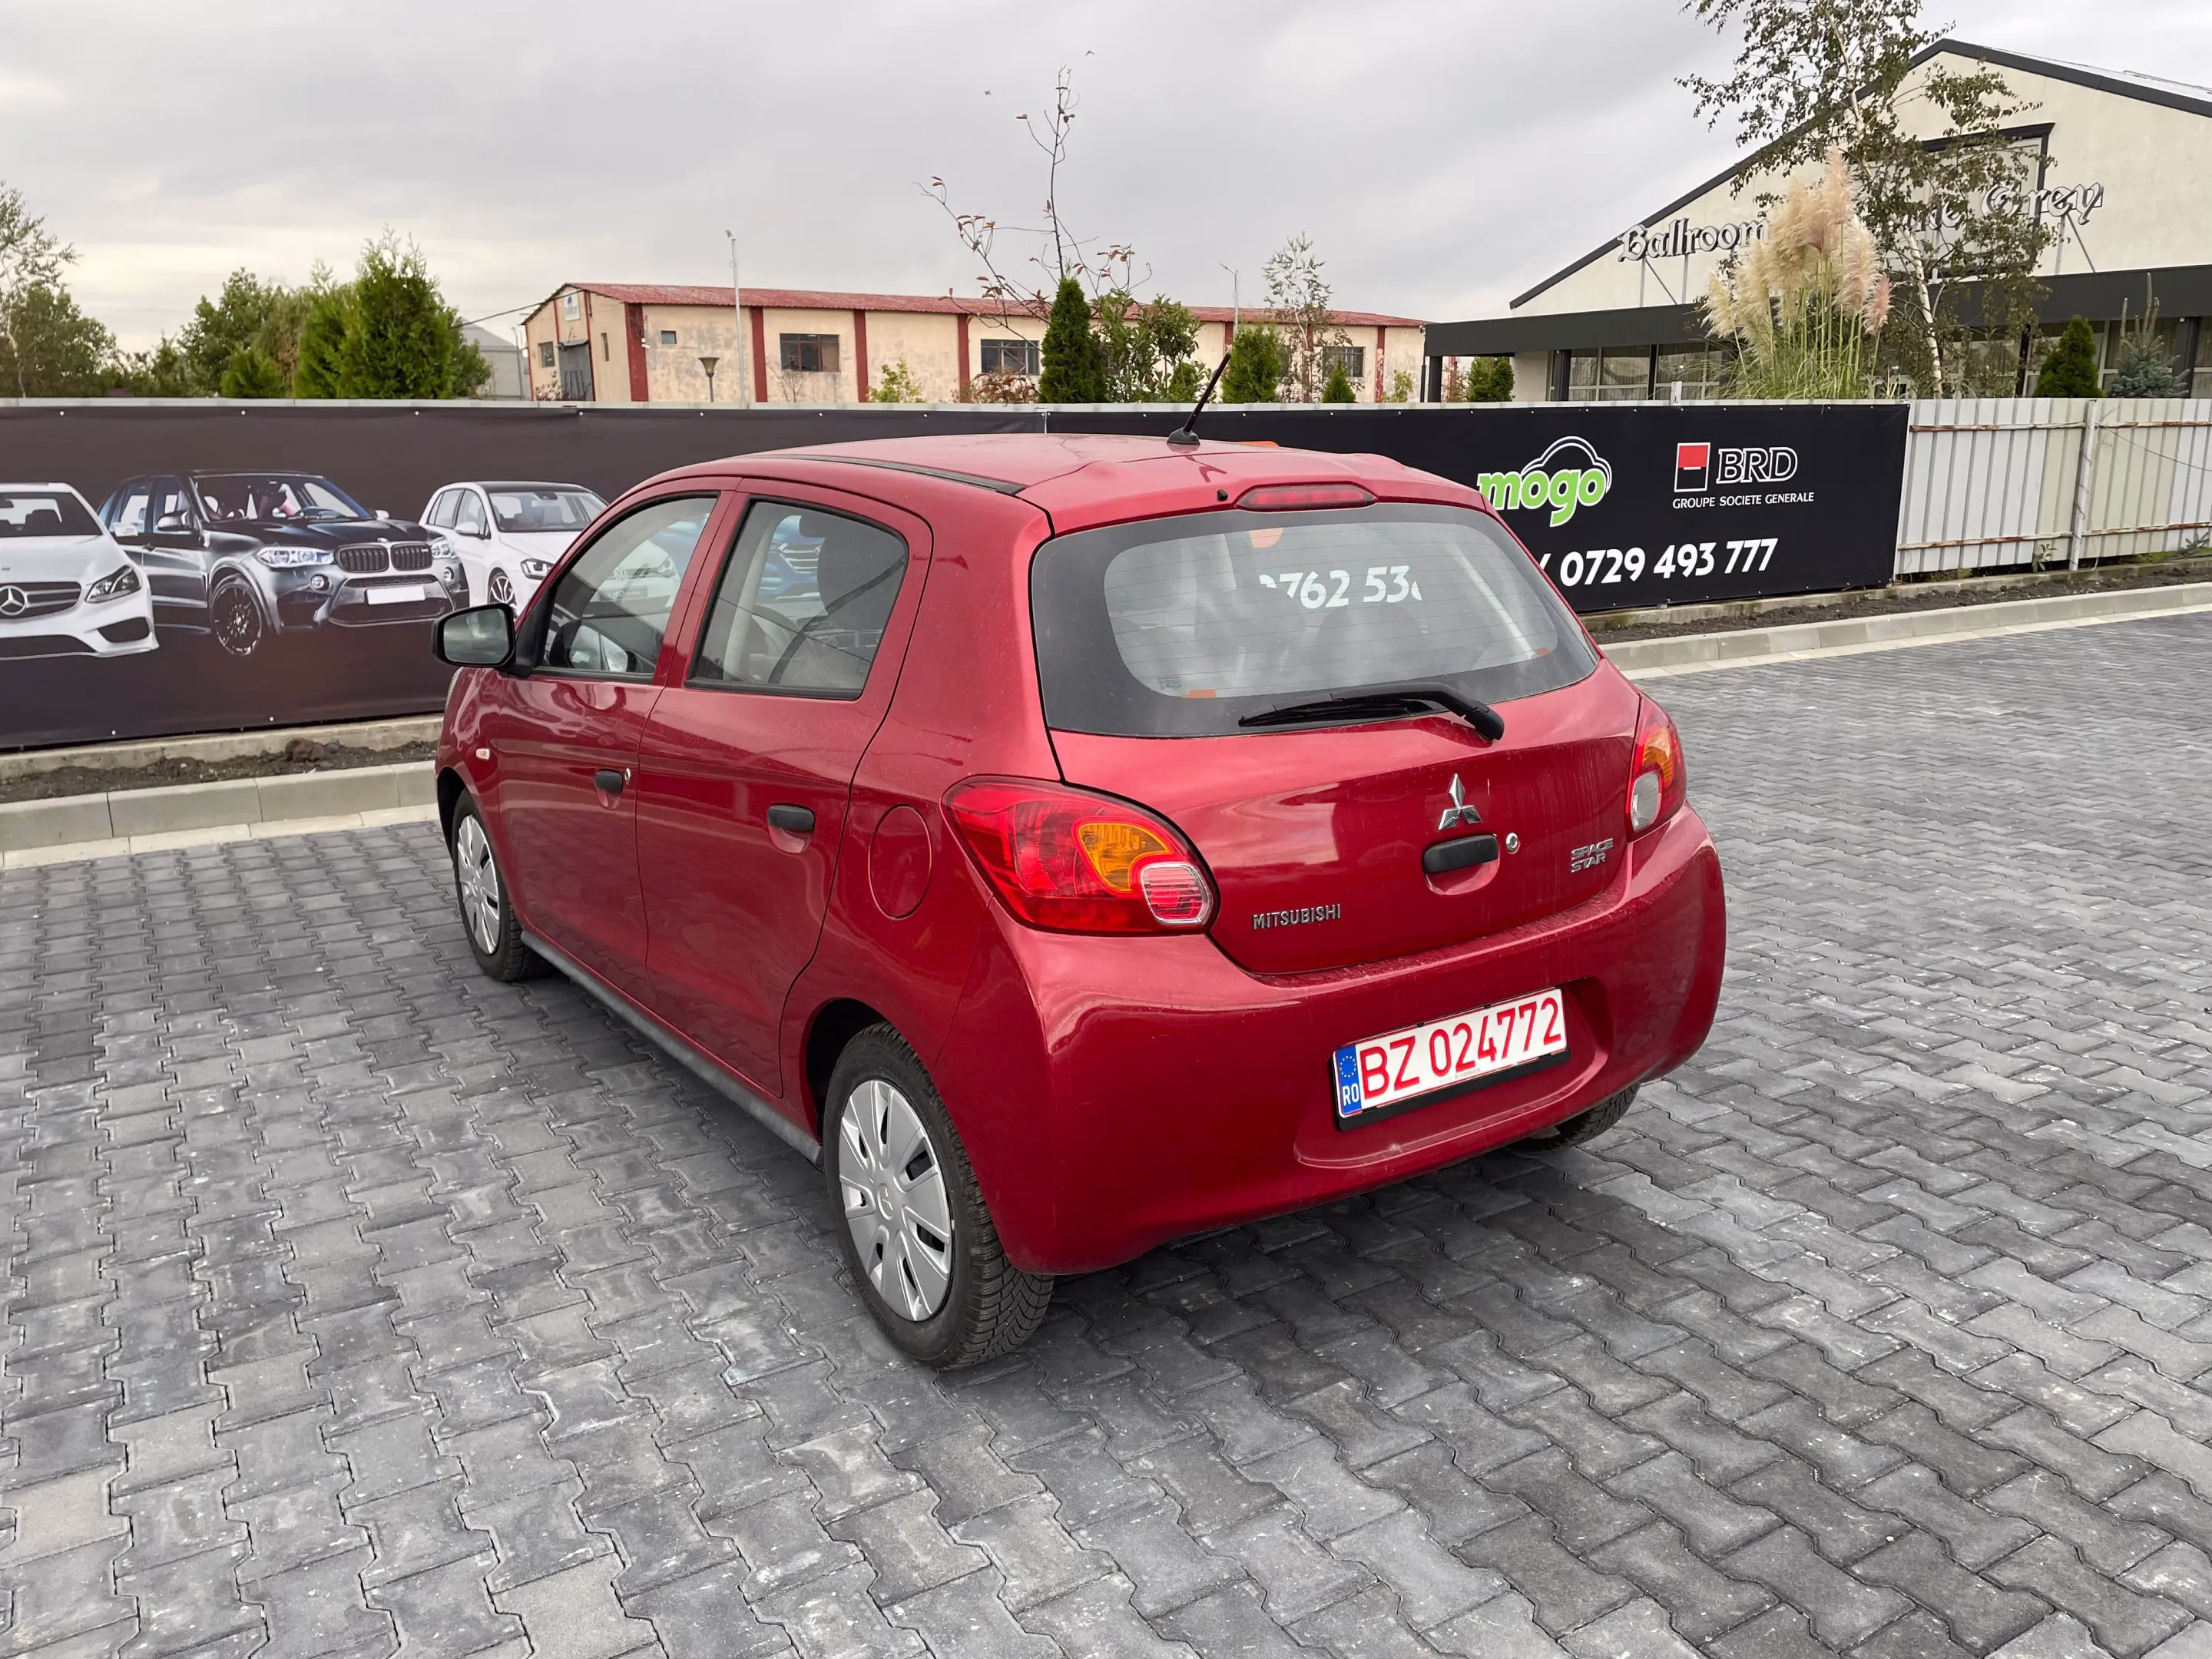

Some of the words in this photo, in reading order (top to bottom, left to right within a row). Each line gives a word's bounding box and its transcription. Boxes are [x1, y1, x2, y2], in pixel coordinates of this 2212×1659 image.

[1618, 218, 1769, 262] Ballroom
[1715, 446, 1798, 485] BRD
[1477, 468, 1608, 528] mogo
[1672, 497, 1716, 509] GROUPE
[1719, 495, 1762, 507] SOCIETE
[1765, 492, 1815, 505] GENERALE
[1259, 569, 1350, 609] 762
[1560, 547, 1646, 587] 0729
[1653, 542, 1715, 579] 493
[1724, 538, 1779, 575] 777
[1571, 837, 1614, 860] SPACE
[1571, 853, 1606, 873] STAR
[1253, 903, 1341, 930] MITSUBISHI
[1342, 1083, 1359, 1107] RO
[1359, 1035, 1420, 1100] BZ
[1429, 997, 1561, 1077] 024772
